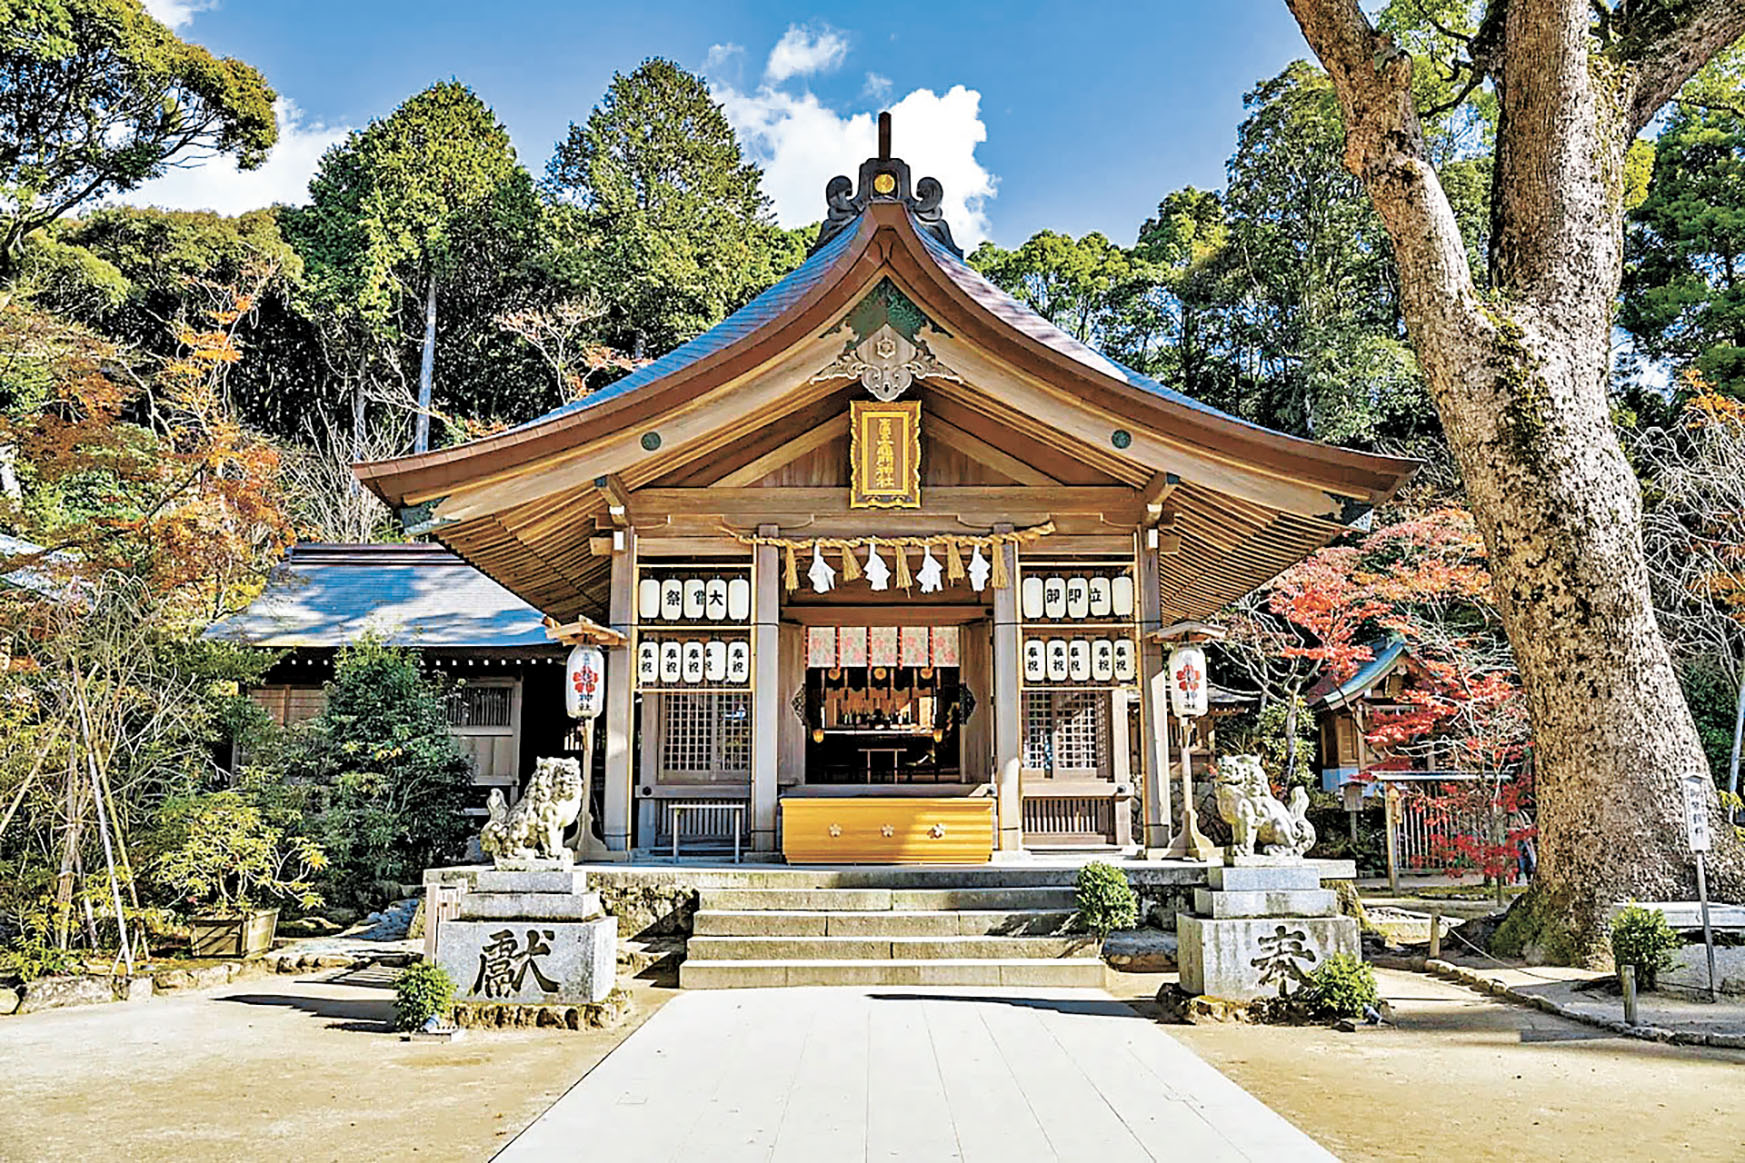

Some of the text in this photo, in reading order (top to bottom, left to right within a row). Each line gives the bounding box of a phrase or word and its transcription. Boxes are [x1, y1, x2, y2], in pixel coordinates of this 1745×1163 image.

[666, 589, 681, 606] 祭
[709, 589, 724, 607] 大
[641, 648, 653, 673] 奉祝
[665, 648, 677, 673] 奉祝
[688, 648, 700, 673] 奉祝
[732, 648, 744, 673] 奉祝
[1027, 646, 1039, 672] 奉祝
[1053, 646, 1065, 672] 奉祝
[1098, 646, 1110, 671] 奉祝
[1115, 646, 1127, 671] 奉祝
[1250, 925, 1317, 997] 奉
